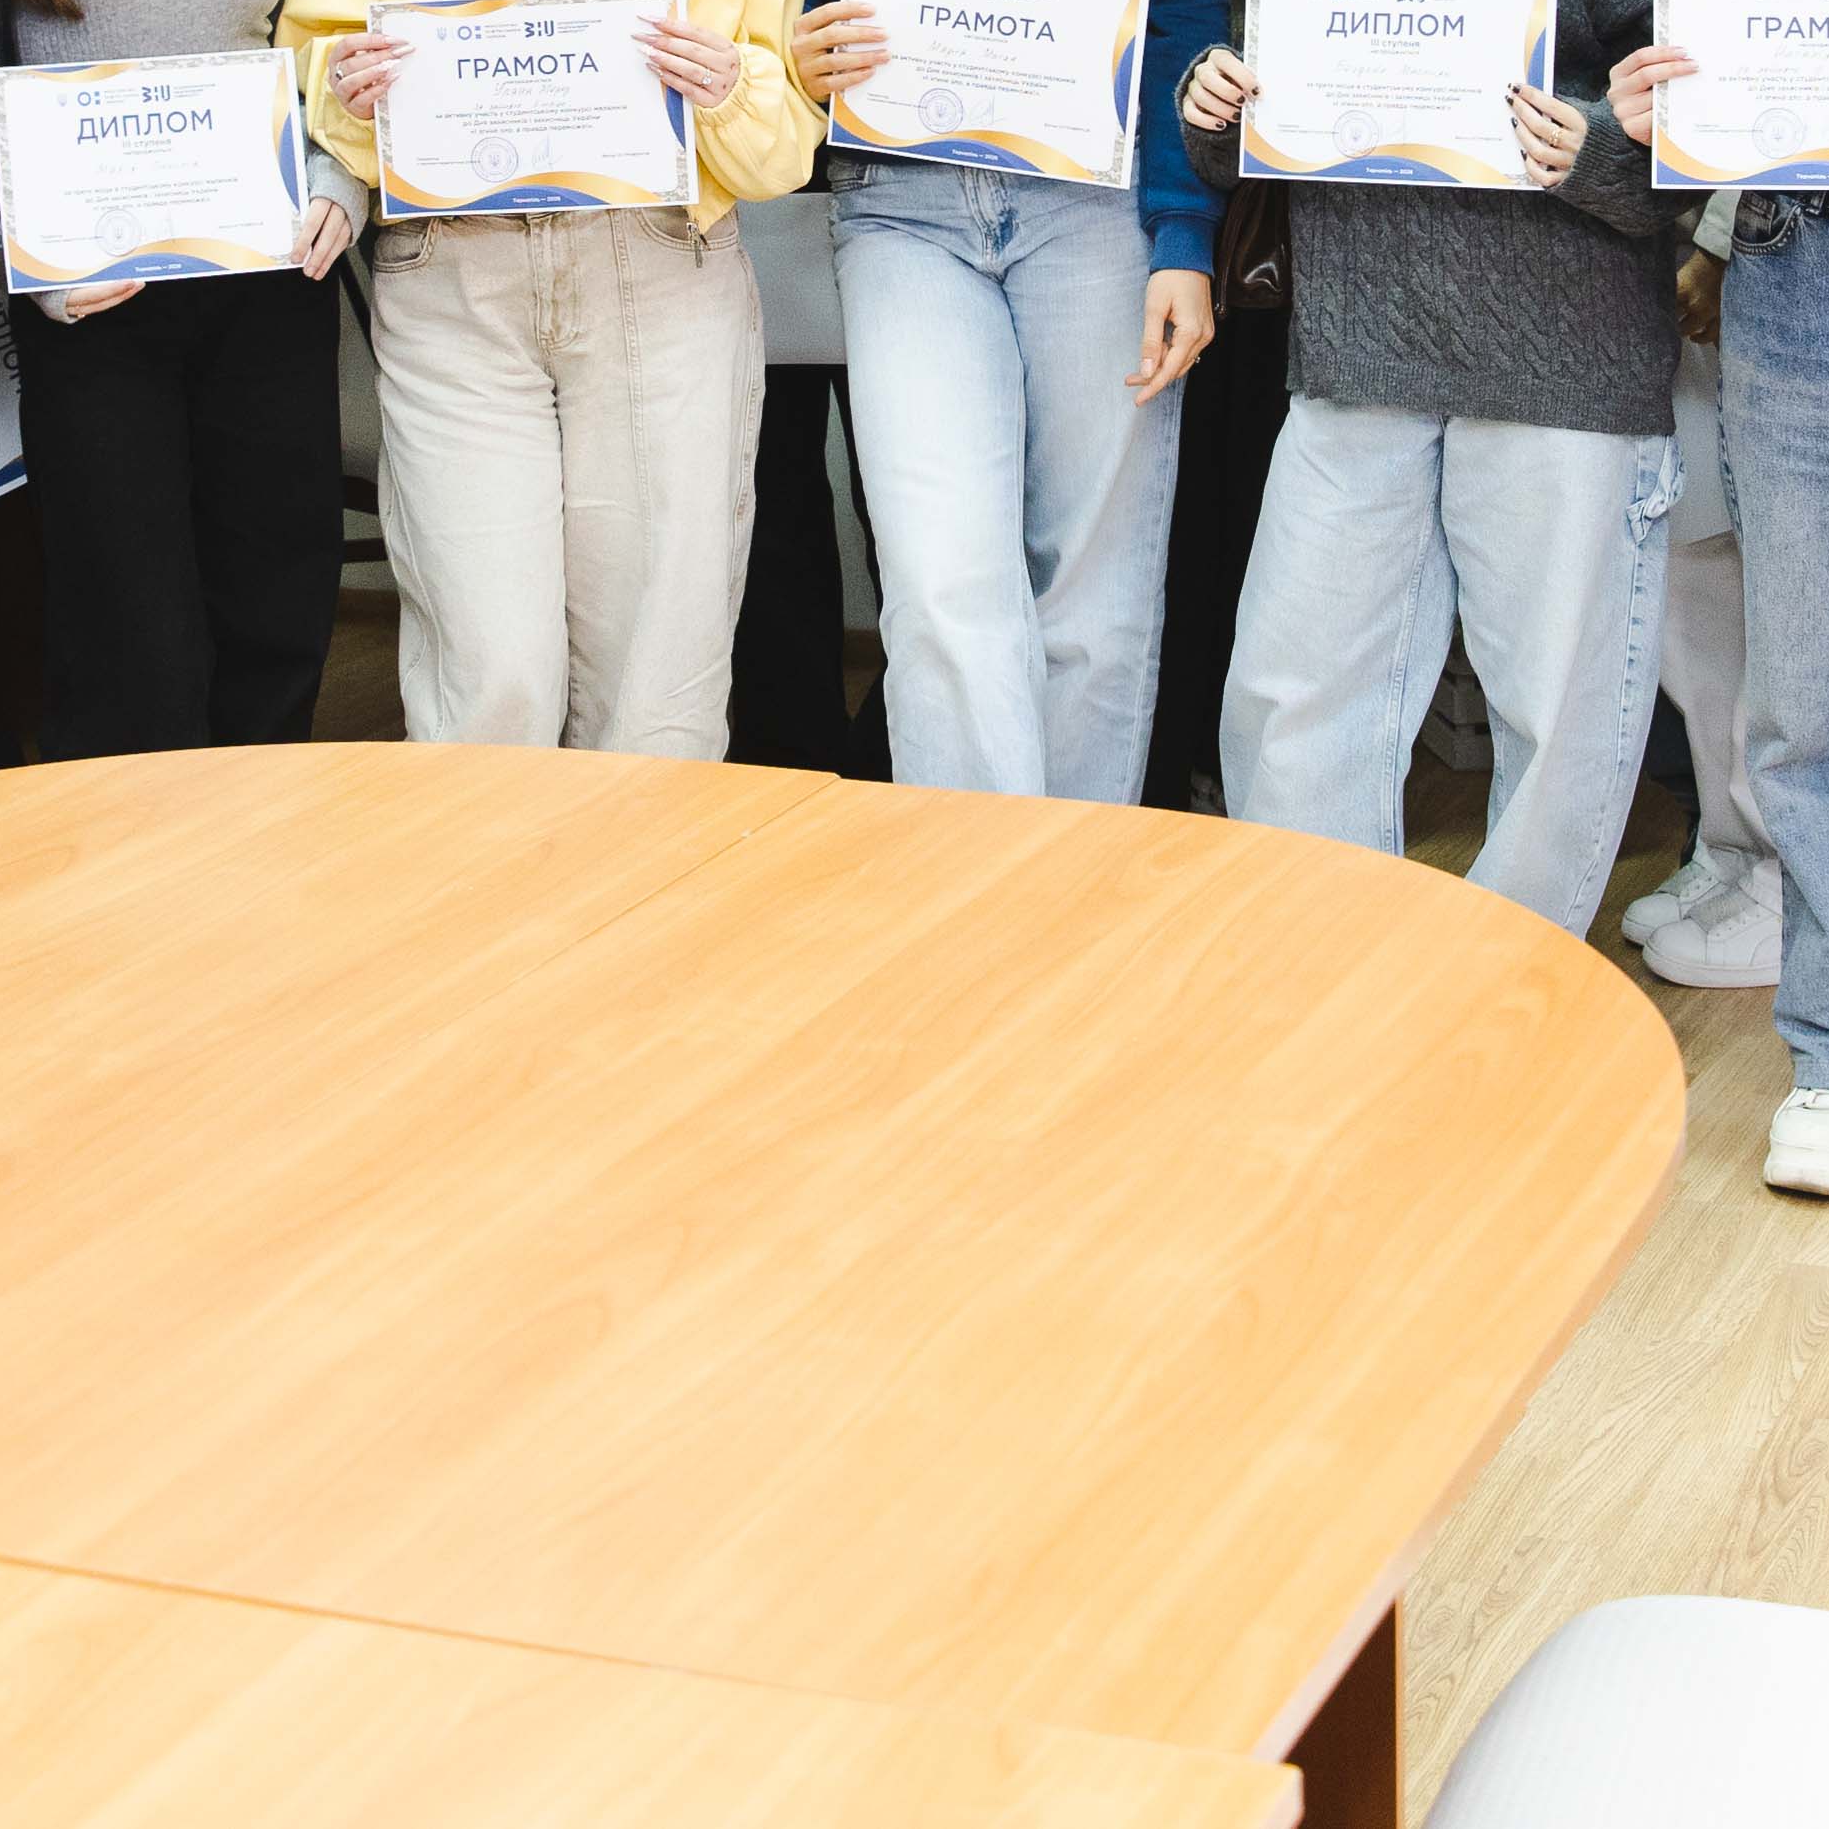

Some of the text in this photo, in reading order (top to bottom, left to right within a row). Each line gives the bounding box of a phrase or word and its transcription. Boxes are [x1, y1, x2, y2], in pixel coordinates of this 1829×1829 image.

[919, 4, 1056, 43] ГРАМОТА
[1326, 11, 1465, 39] ДИПЛОМ
[1381, 39, 1421, 50] ступеня
[457, 52, 599, 79] ГРАМОТА
[77, 109, 214, 145] ДИПЛОМ
